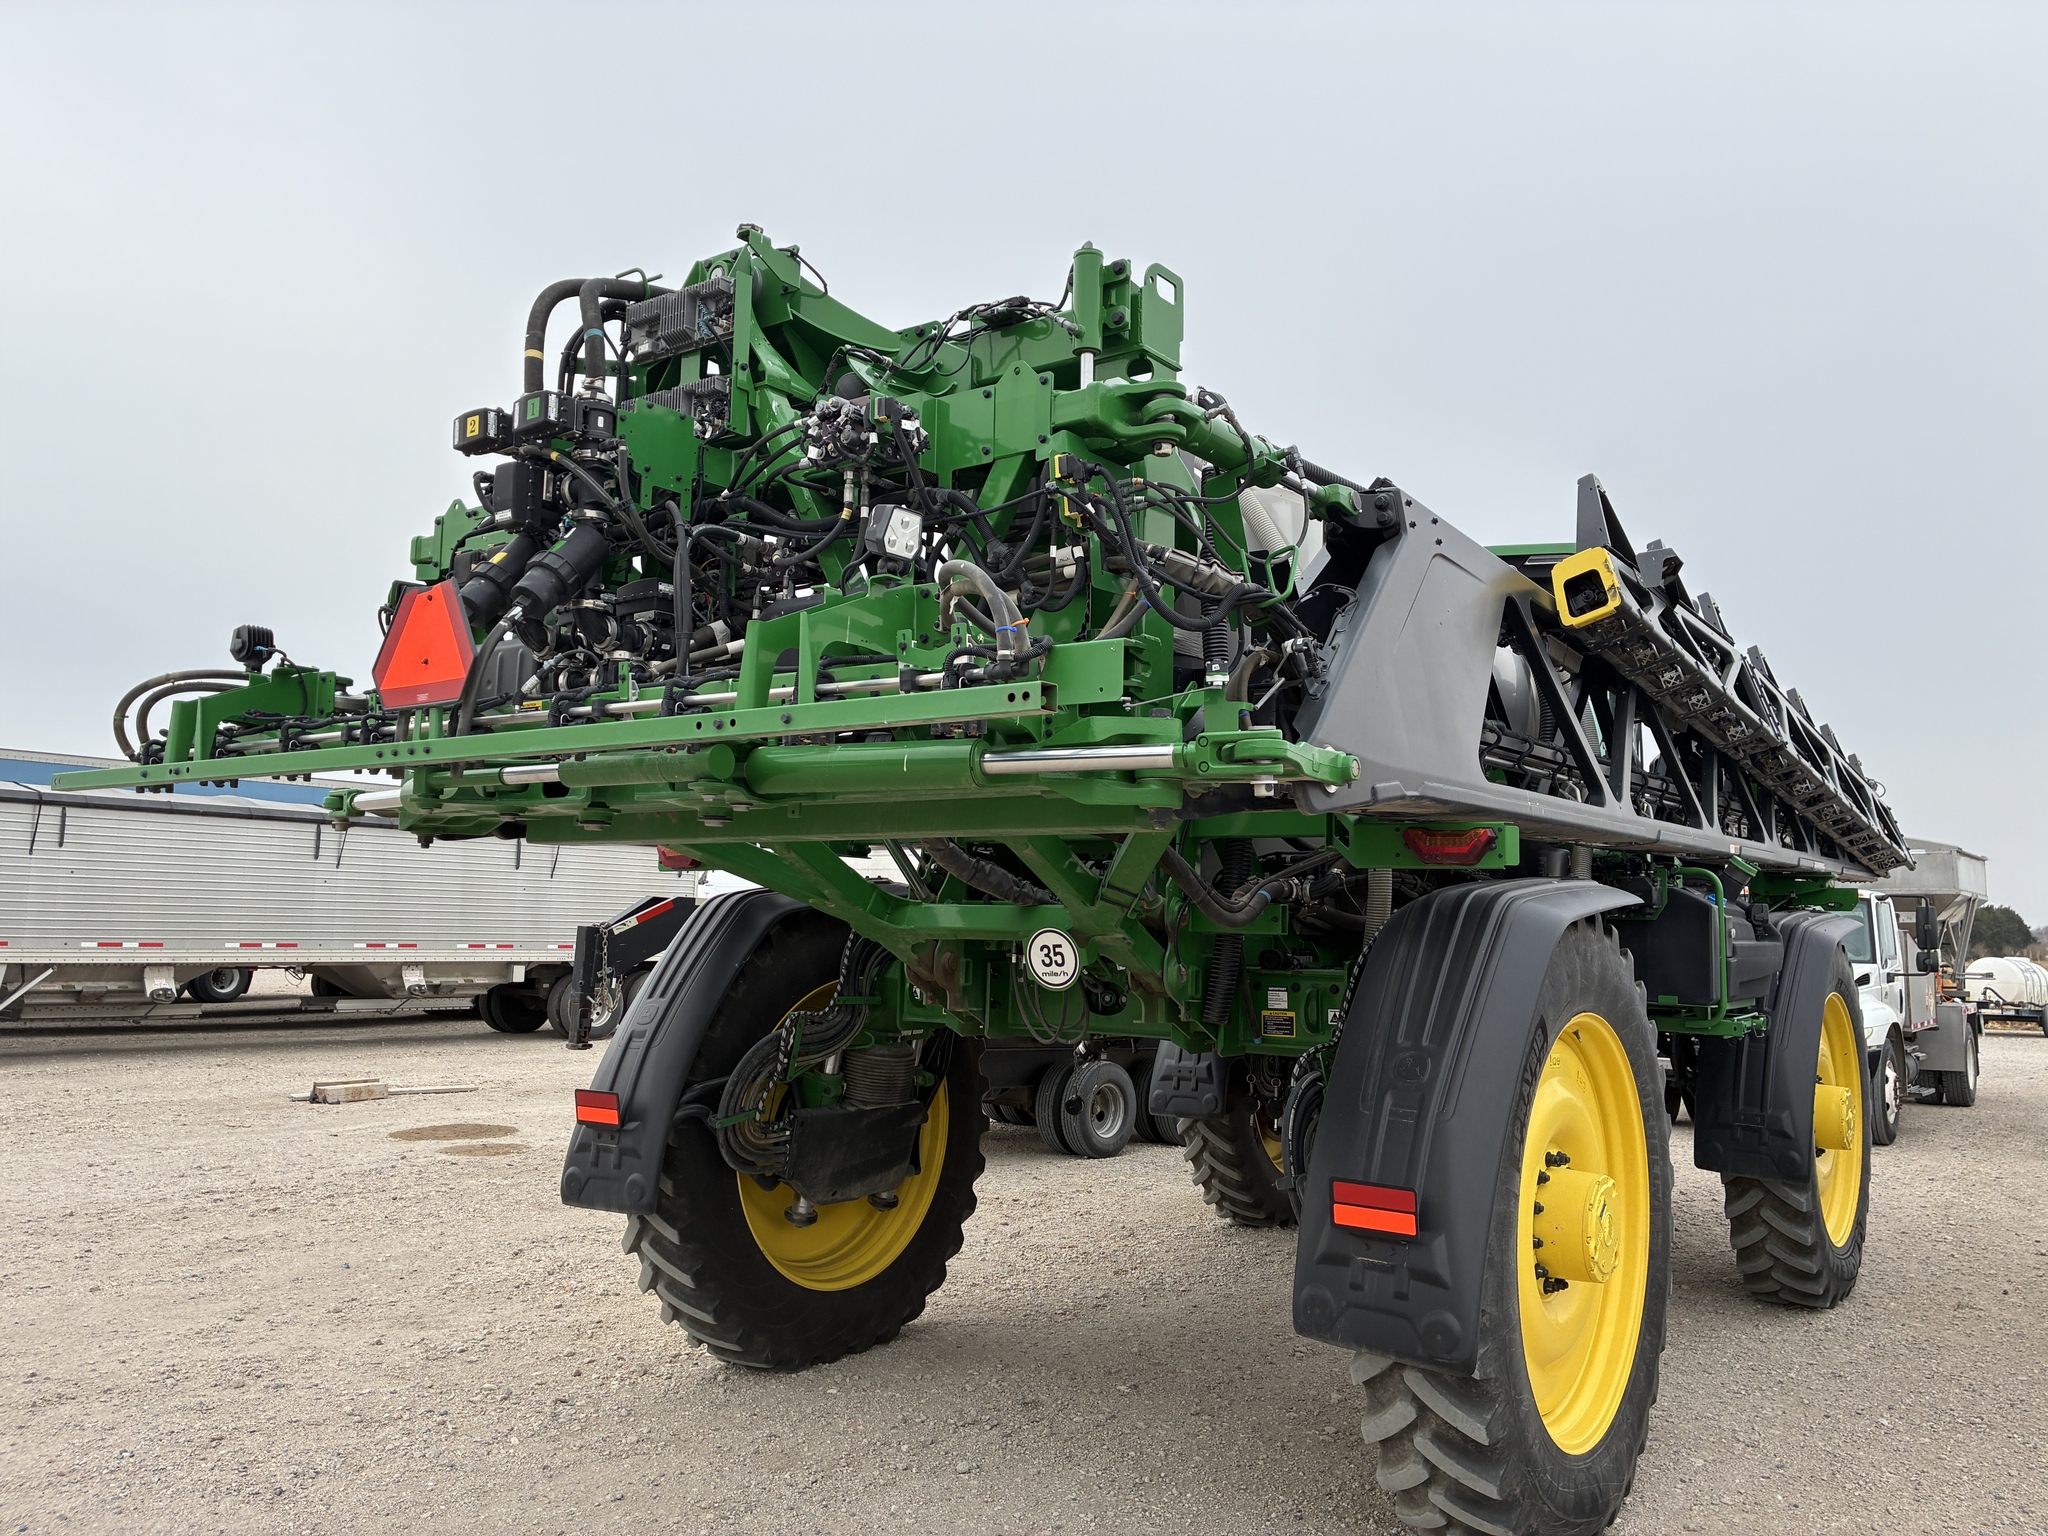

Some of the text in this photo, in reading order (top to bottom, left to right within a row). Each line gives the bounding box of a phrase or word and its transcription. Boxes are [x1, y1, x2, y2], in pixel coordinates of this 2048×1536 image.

[531, 402, 536, 416] 1
[469, 419, 476, 434] 2
[1040, 944, 1066, 967] 35
